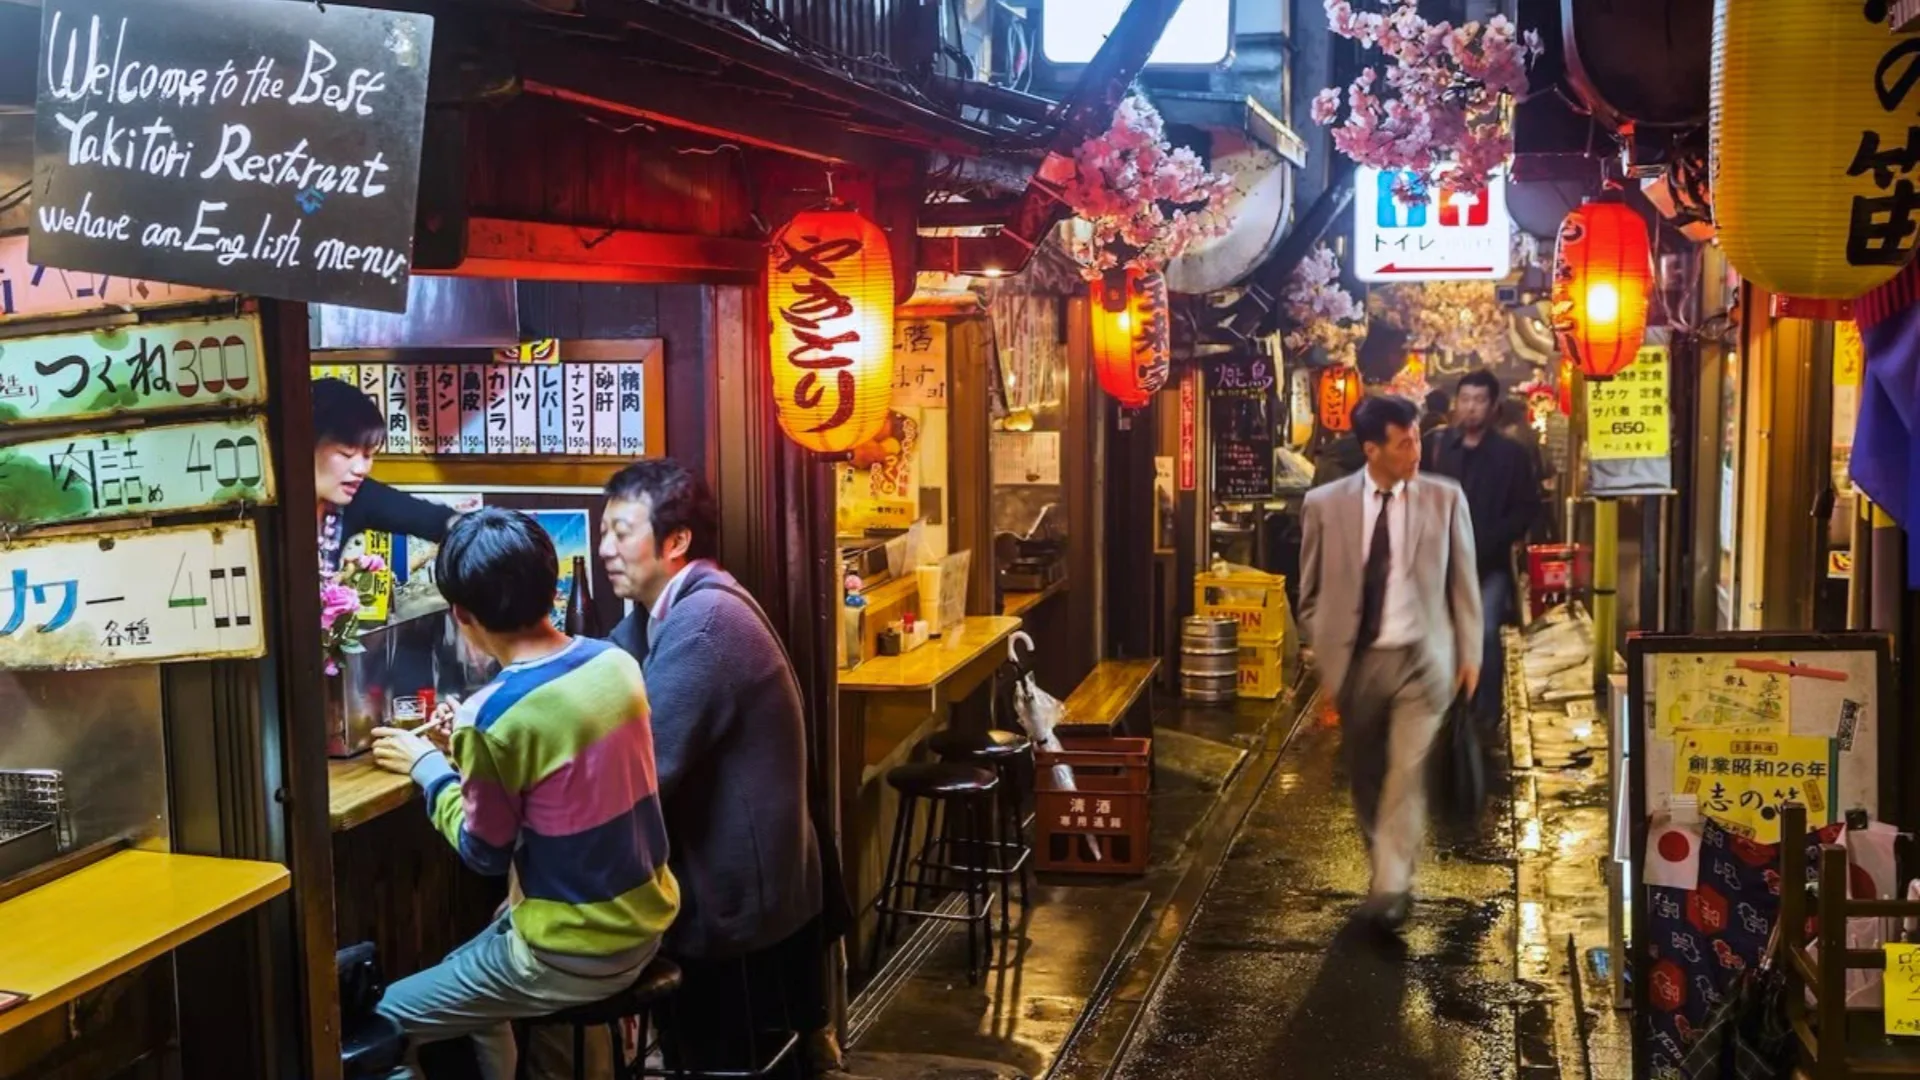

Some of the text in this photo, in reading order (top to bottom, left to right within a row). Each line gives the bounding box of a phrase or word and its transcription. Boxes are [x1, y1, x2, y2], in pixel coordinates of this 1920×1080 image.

[47, 10, 386, 116] Welcome to the Best
[1374, 232, 1436, 253] トイレ
[776, 235, 864, 433] やきとり
[34, 337, 173, 399] つくね
[172, 334, 251, 398] 300
[438, 372, 455, 411] タン
[514, 372, 531, 411] ハツ
[595, 371, 615, 412] 砂肝
[620, 371, 641, 412] 精肉
[389, 372, 408, 432] バラ肉
[487, 371, 507, 431] カシラ
[541, 369, 559, 428] レバー
[570, 371, 585, 433] ナンコツ
[1611, 421, 1646, 435] 650
[186, 433, 262, 493] 400
[101, 618, 152, 646] 各種
[1688, 755, 1828, 779] 創業昭和26年
